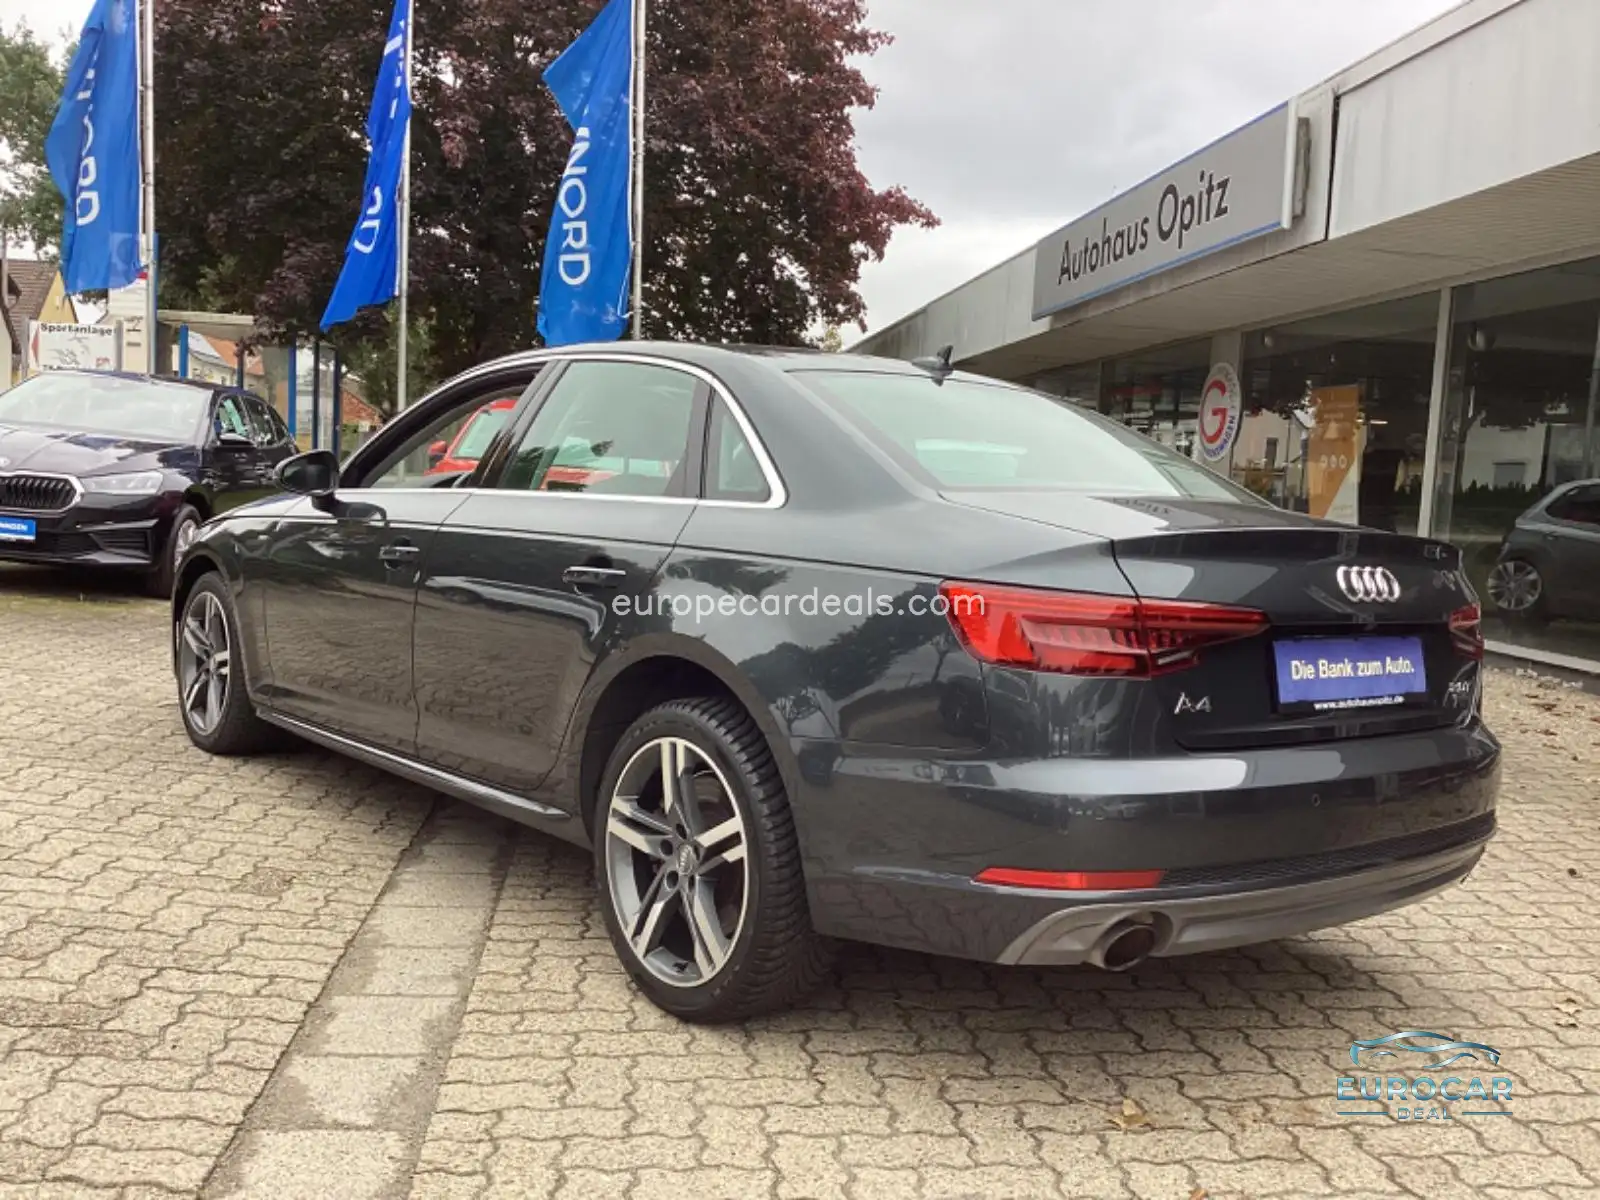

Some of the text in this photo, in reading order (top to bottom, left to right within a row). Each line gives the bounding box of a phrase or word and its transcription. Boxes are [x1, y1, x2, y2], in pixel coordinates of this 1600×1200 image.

[1058, 170, 1230, 286] Autohaus Opitz
[1200, 379, 1229, 444] G
[1290, 656, 1415, 680] Die Bank zum Auto.
[1174, 691, 1212, 715] A4
